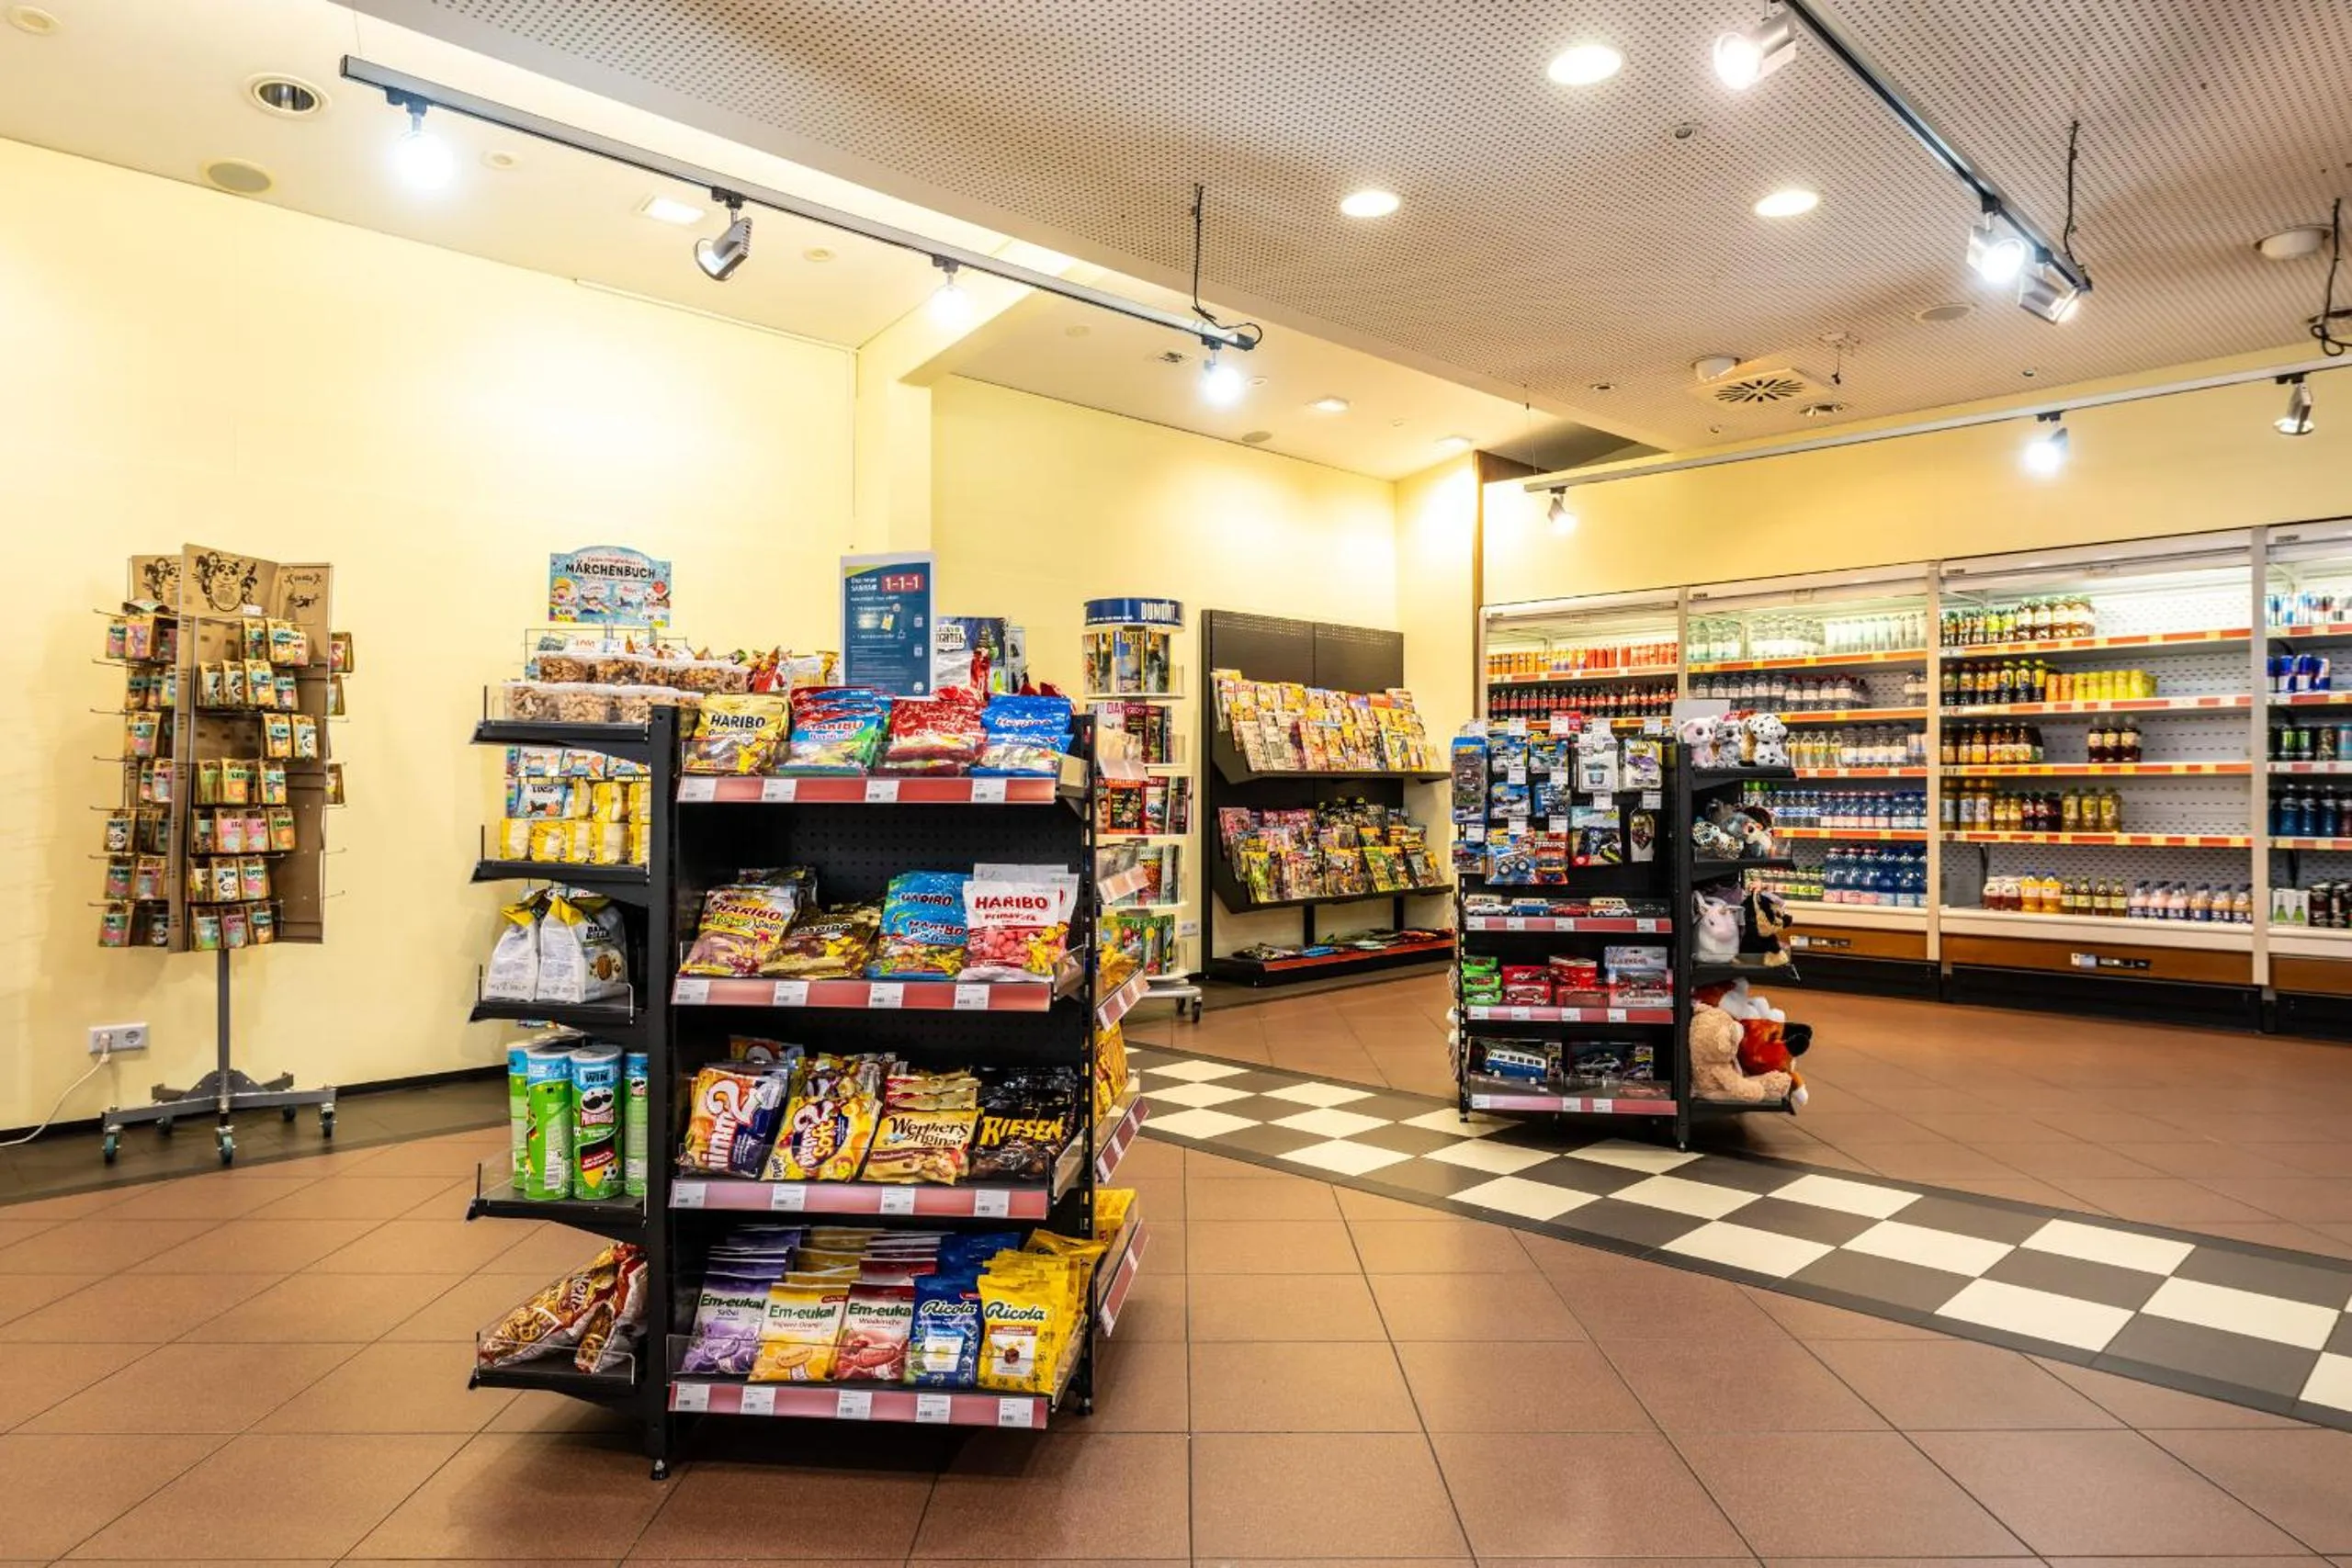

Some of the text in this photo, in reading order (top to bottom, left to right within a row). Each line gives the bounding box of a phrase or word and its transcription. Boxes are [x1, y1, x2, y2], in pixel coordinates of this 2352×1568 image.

[565, 559, 656, 579] MÄRCHENBUCH
[885, 575, 920, 590] 1-1-1
[1140, 602, 1177, 622] DUMONT
[710, 715, 766, 728] HARIBO
[975, 897, 1049, 909] HARIBO
[716, 903, 782, 920] HARIBO
[586, 1071, 609, 1083] WIN
[978, 1115, 1064, 1146] RIESEN
[700, 1293, 765, 1310] Em-eukal
[922, 1299, 977, 1315] Ricola
[768, 1304, 836, 1318] Em-eukal
[848, 1303, 911, 1317] Em-euka
[985, 1301, 1045, 1320] Ricola
